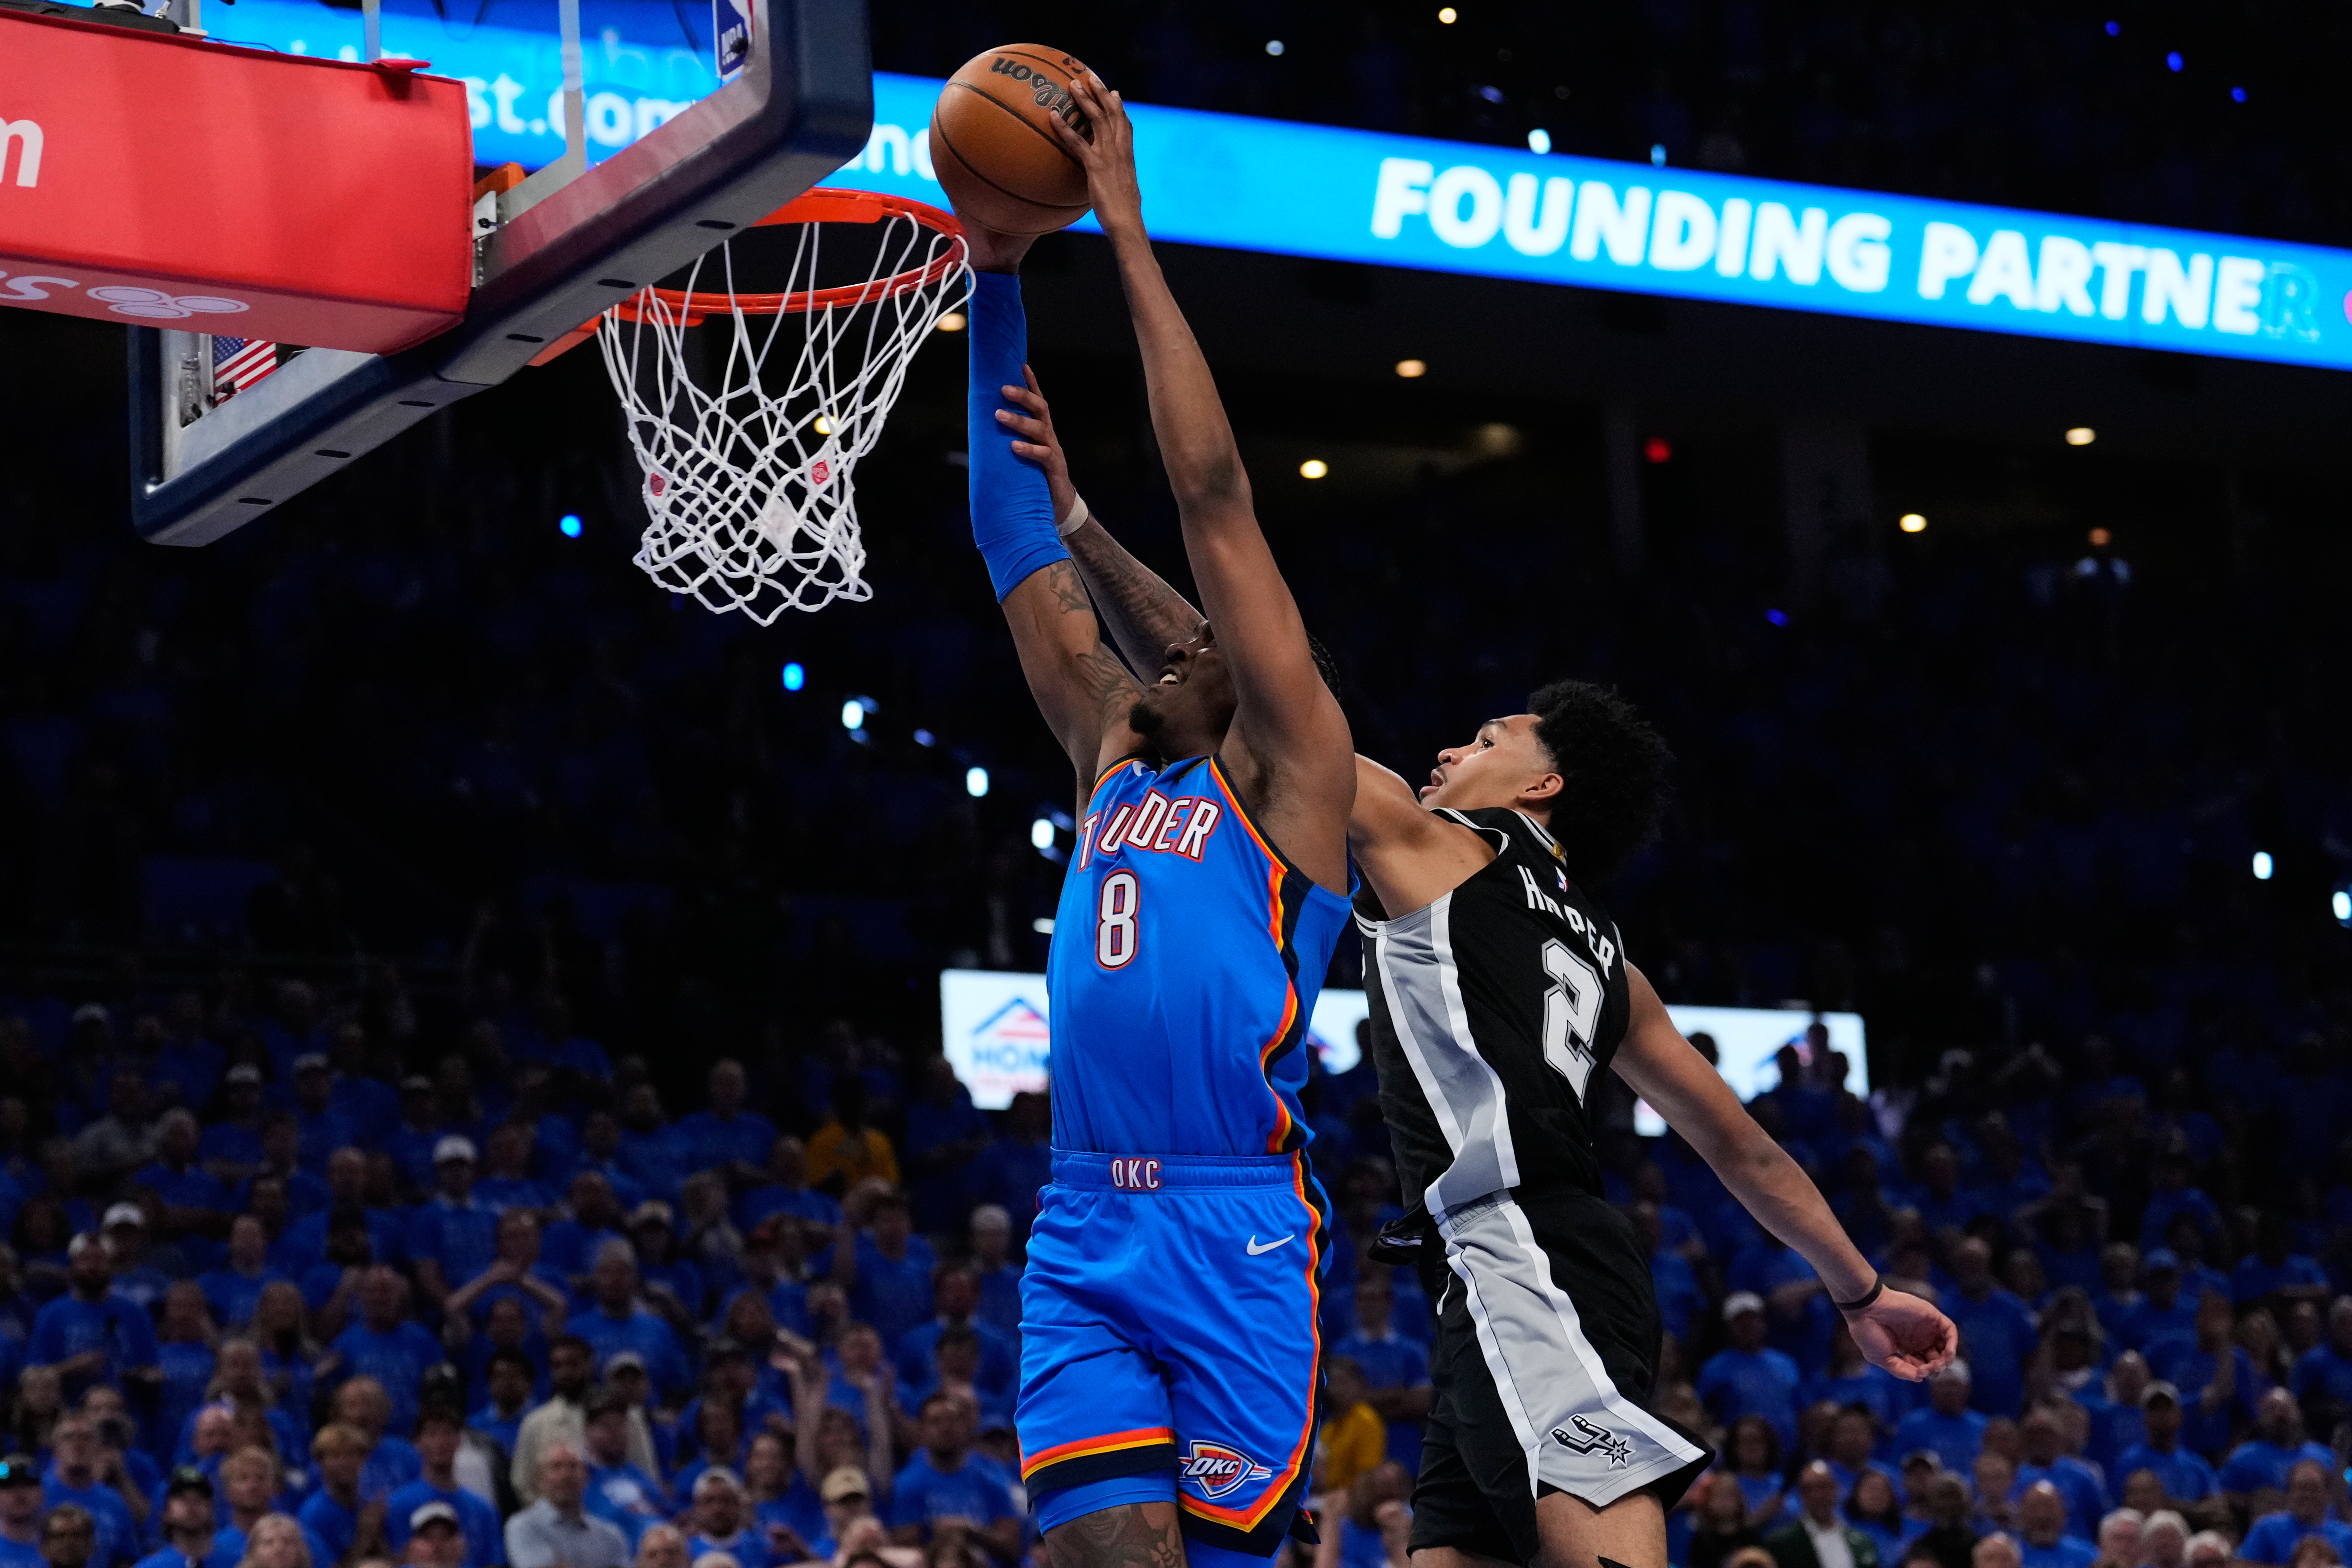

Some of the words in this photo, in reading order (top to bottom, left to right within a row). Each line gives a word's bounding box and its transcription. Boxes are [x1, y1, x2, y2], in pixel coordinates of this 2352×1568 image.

[1370, 156, 1892, 294] FOUNDING
[1077, 786, 1223, 874] TUDER
[1095, 868, 1140, 971] 8
[1541, 937, 1605, 1109] 2
[1111, 1158, 1160, 1190] OKC
[1186, 1457, 1241, 1476] OKC
